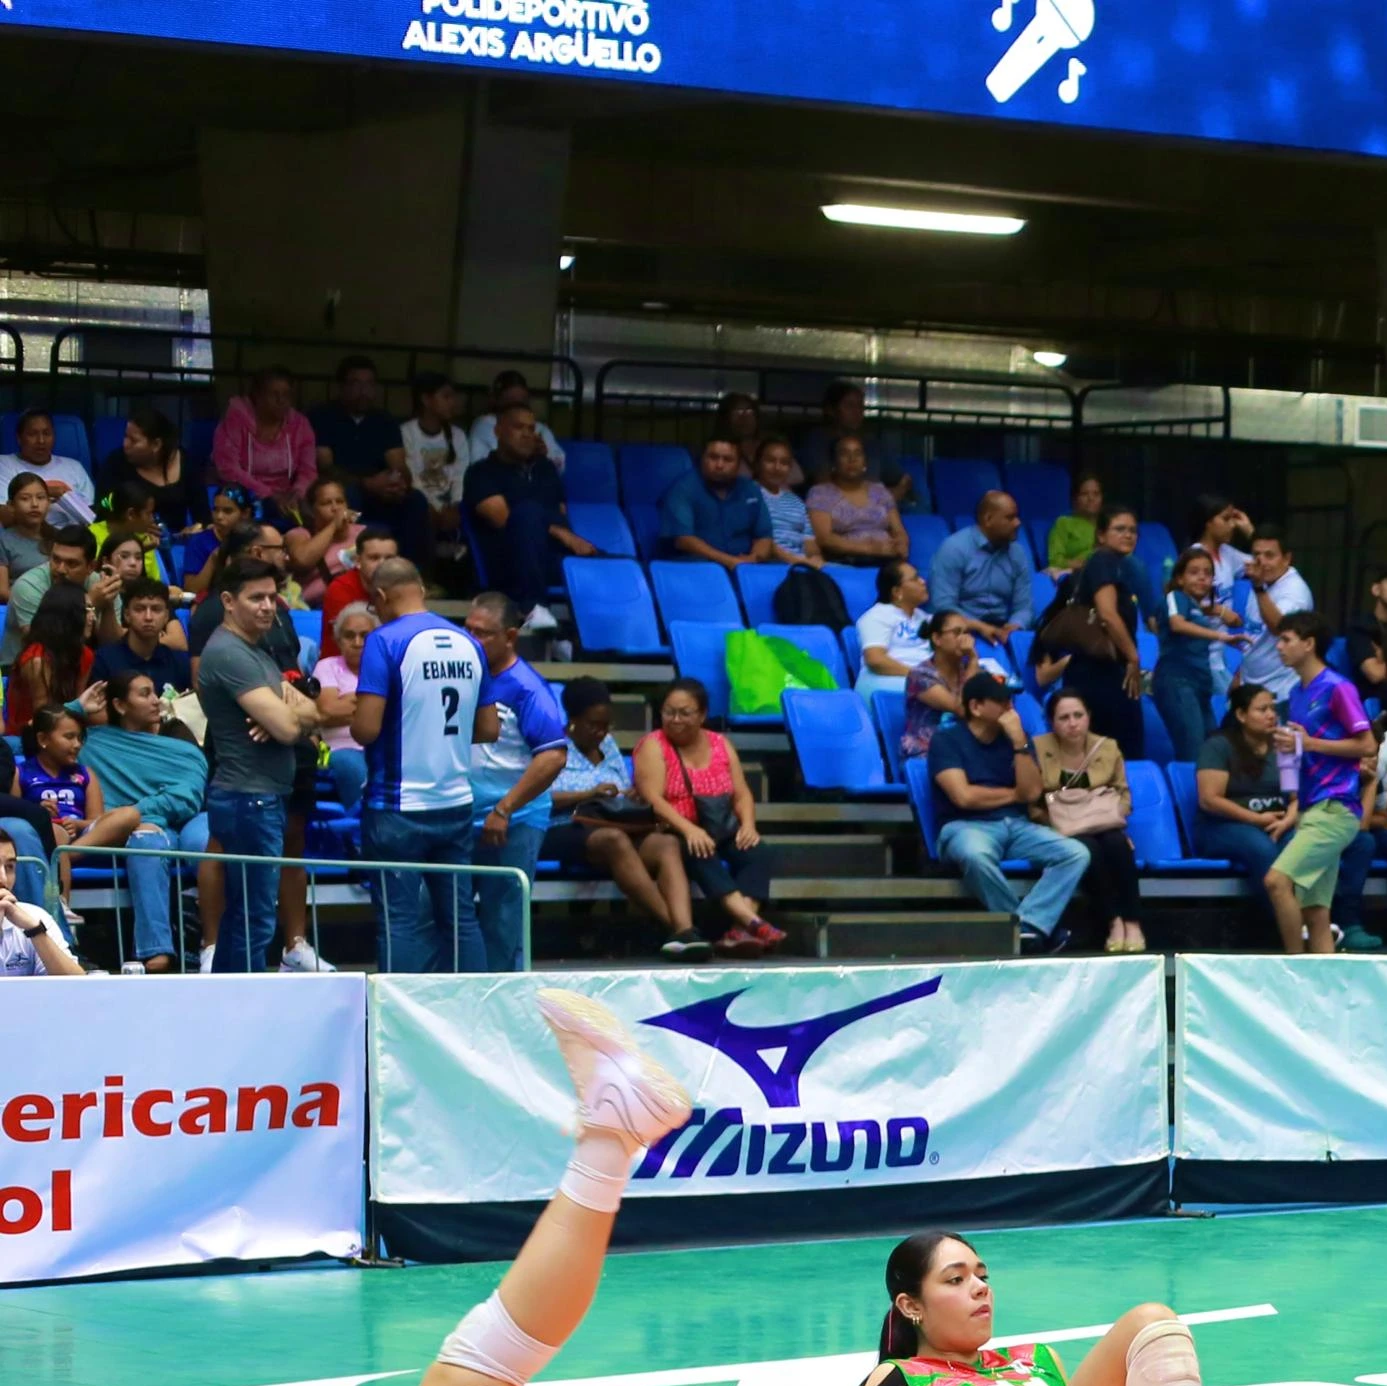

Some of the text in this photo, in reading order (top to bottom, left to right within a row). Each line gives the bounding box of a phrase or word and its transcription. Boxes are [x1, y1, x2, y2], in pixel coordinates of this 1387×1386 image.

[402, 20, 662, 73] ALEXIS ARGÜELLO
[422, 661, 473, 680] EBANKS
[441, 686, 460, 735] 2
[632, 1107, 929, 1179] MIZUNO
